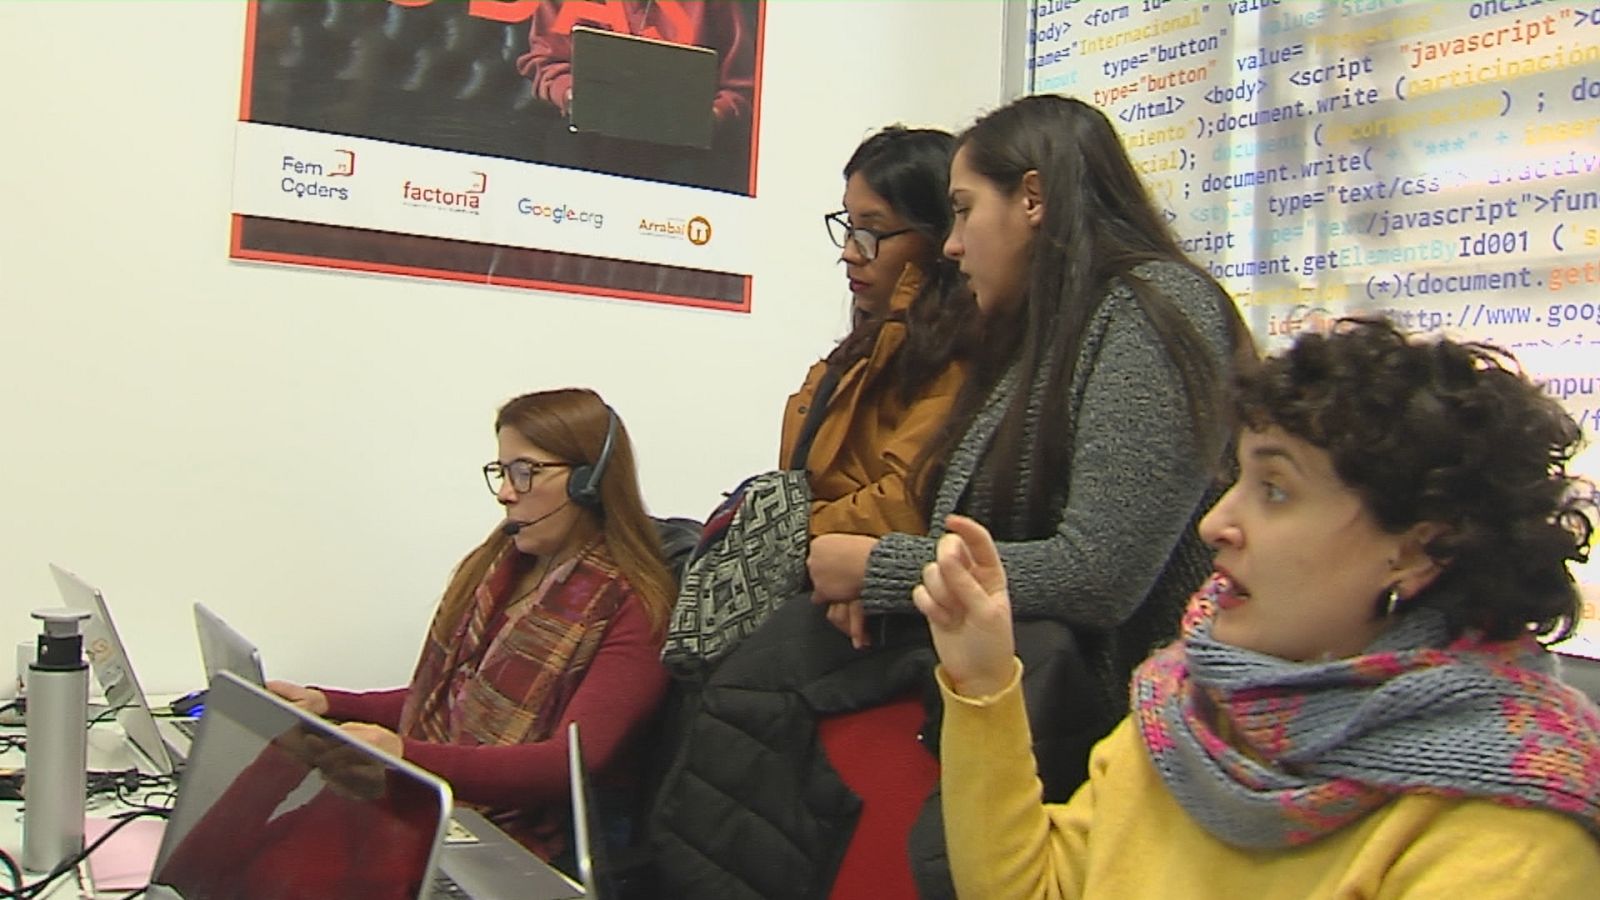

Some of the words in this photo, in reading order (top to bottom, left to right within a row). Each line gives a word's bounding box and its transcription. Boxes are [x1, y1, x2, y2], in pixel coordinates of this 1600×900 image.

[1084, 5, 1129, 27] <form
[1119, 95, 1185, 122] </html>
[1204, 79, 1267, 104] <body>
[1289, 57, 1373, 86] <script
[282, 155, 323, 176] Fem
[281, 177, 349, 201] Coders
[518, 197, 604, 229] Google.org
[1366, 262, 1600, 300] (){document.get
